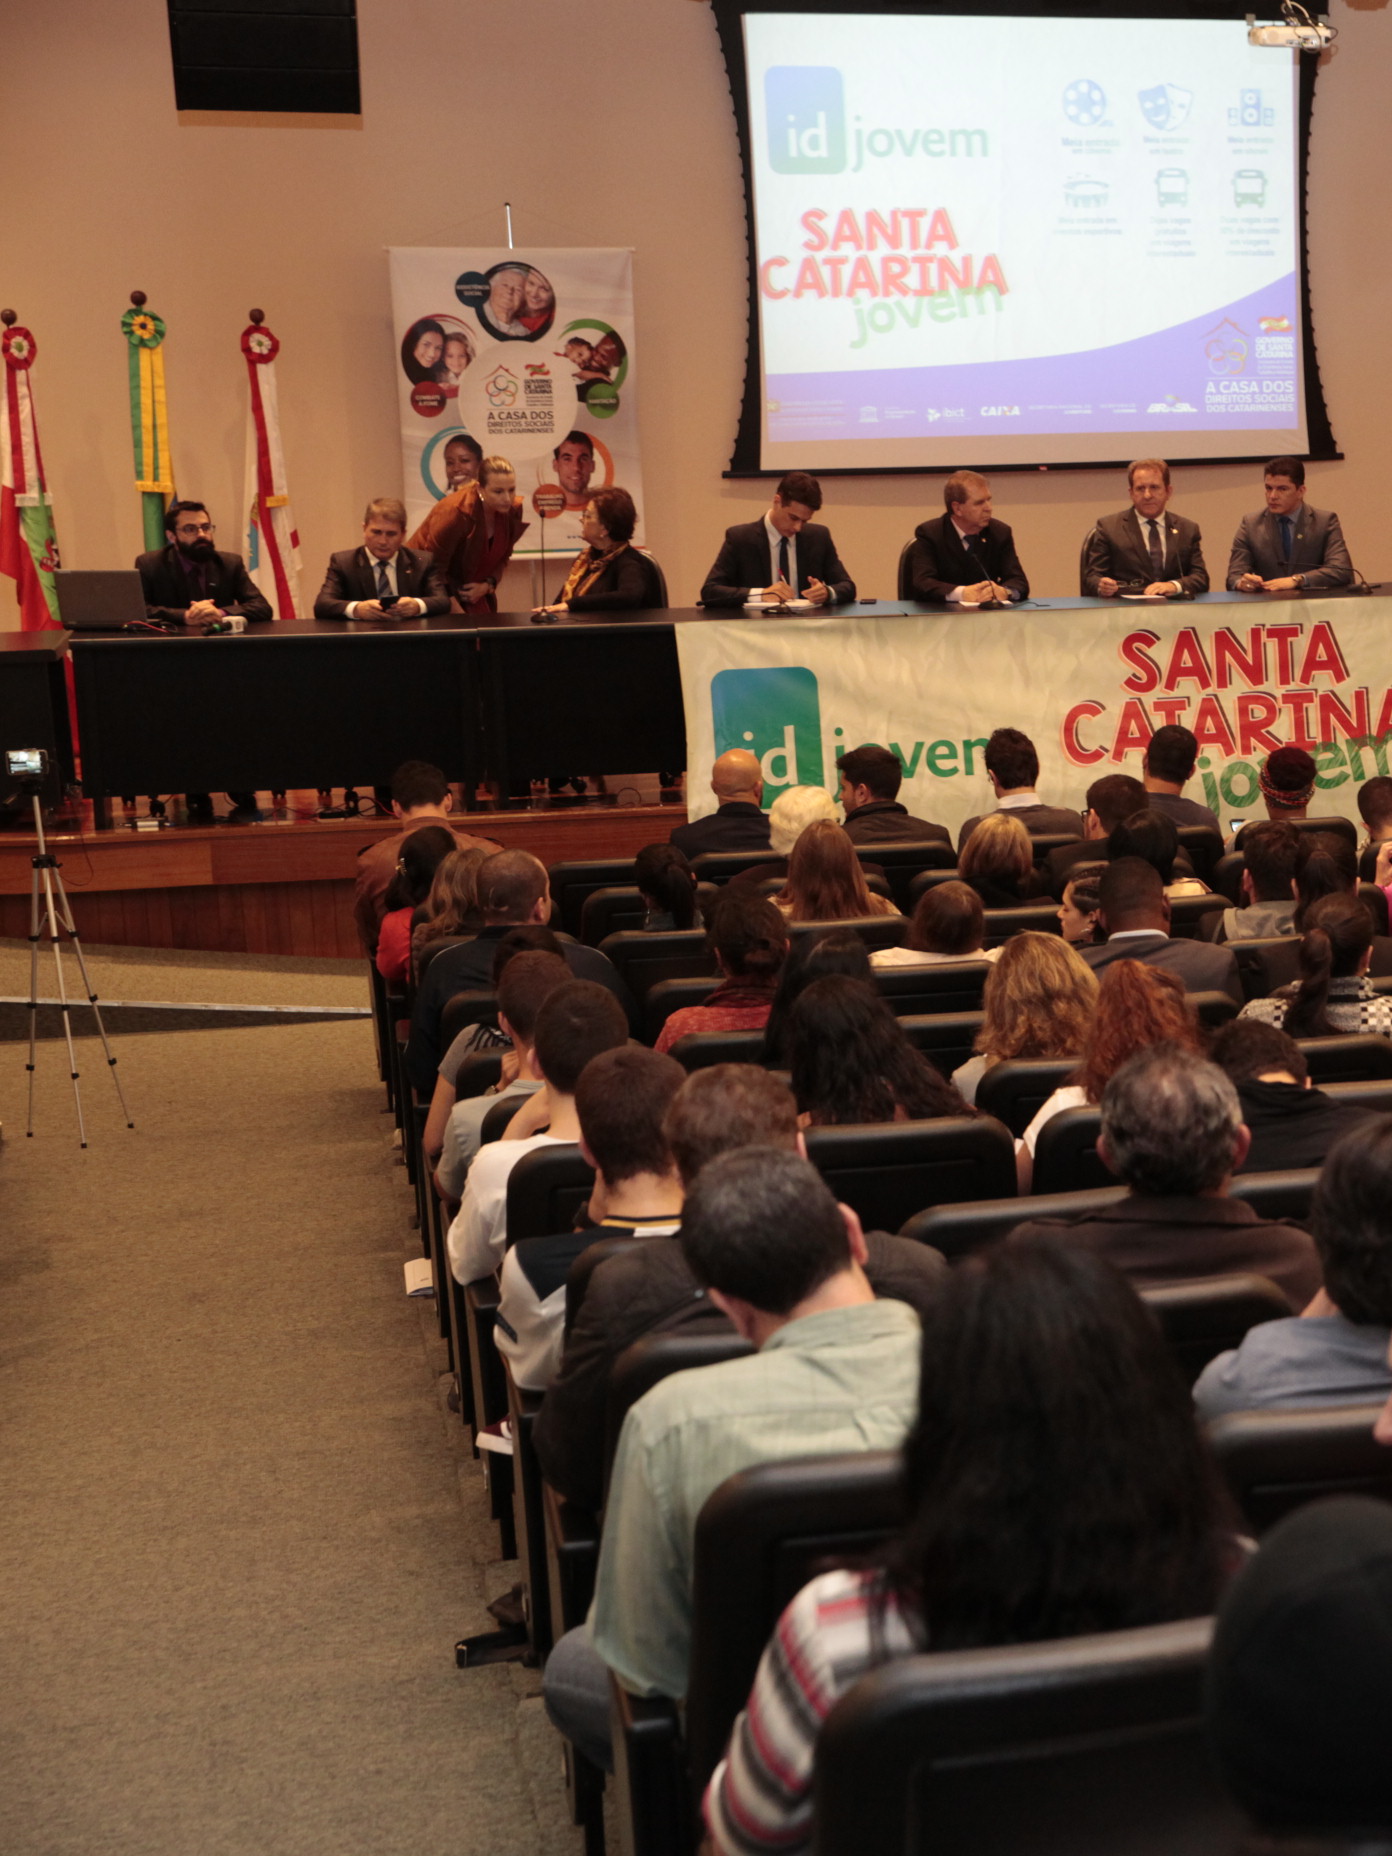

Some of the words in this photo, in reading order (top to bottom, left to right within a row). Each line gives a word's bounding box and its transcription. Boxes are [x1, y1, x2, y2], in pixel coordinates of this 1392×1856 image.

[786, 111, 829, 158] id
[851, 115, 989, 173] jovem
[800, 207, 960, 253] SANTA
[760, 253, 1010, 300] CATARINA
[849, 282, 1005, 349] jovem
[1205, 394, 1252, 404] DIREITOS
[1254, 394, 1295, 403] SOCIAIS
[1206, 381, 1216, 393] A
[1219, 381, 1259, 393] CASA
[1263, 381, 1294, 393] DOS
[1206, 404, 1226, 413] DOS
[1228, 403, 1294, 413] CATARINENSES
[487, 411, 495, 420] A
[498, 411, 528, 420] CASA
[530, 411, 554, 420] DOS
[980, 406, 1021, 417] CAIXA
[1118, 620, 1350, 697] SANTA
[743, 724, 799, 787] d
